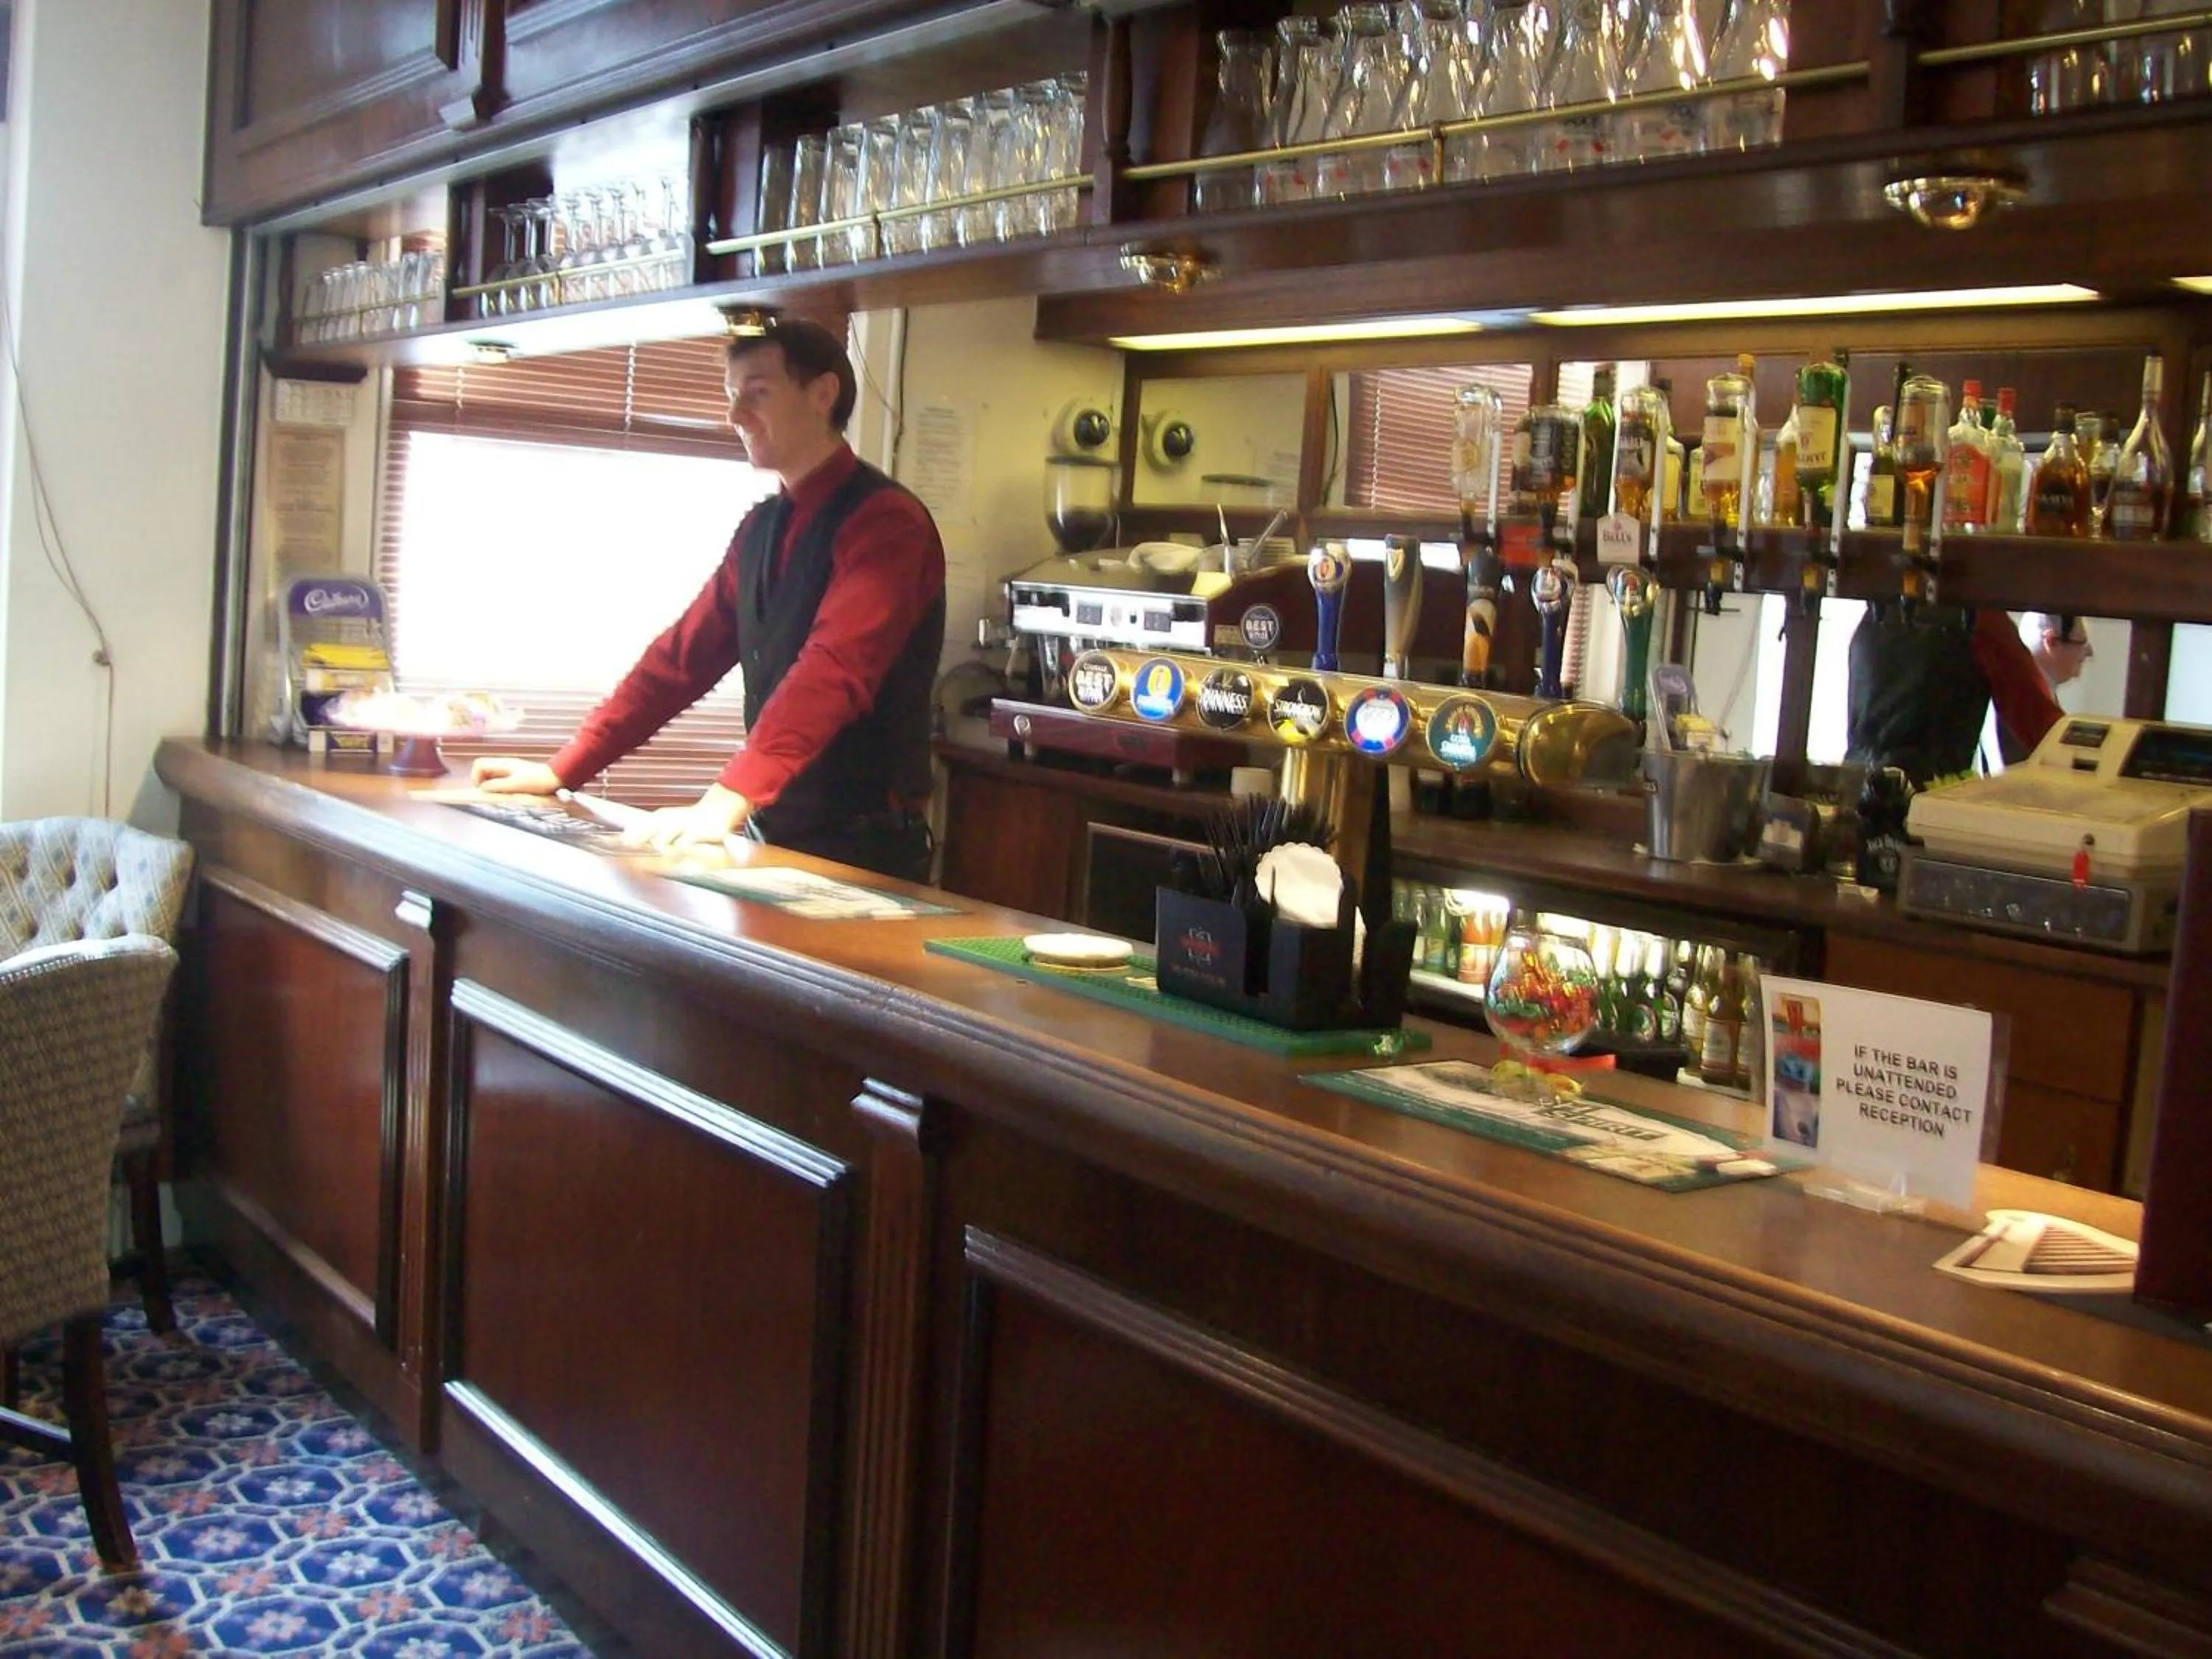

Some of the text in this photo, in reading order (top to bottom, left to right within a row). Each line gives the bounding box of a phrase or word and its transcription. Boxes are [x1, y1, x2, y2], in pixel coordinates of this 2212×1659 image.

[304, 588, 369, 613] Cadbury
[1854, 1043, 1958, 1080] IF THE BAR IS
[1853, 1062, 1957, 1099] UNATTENDED
[1836, 1077, 1972, 1123] PLEASE CONTACT
[1859, 1102, 1944, 1137] RECEPTION
